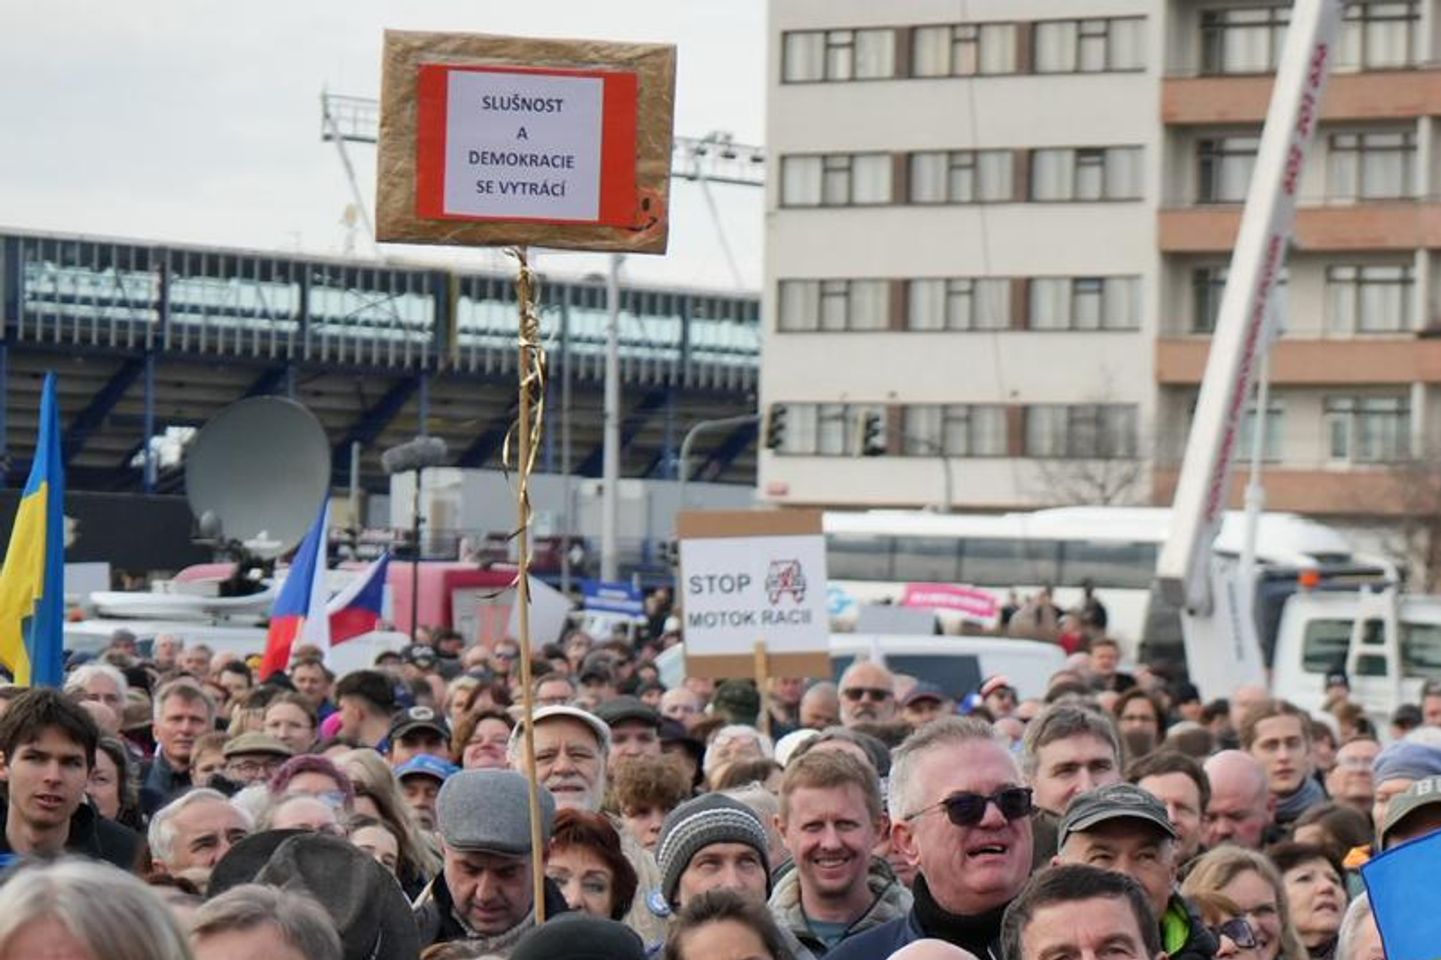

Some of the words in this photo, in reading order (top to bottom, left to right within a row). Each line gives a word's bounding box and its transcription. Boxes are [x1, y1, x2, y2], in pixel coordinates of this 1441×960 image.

[482, 94, 563, 113] SLUŠNOST
[516, 126, 528, 140] A
[468, 150, 575, 169] DEMOKRACIE
[477, 180, 494, 195] SE
[499, 180, 566, 197] VYTRÁCÍ
[689, 573, 751, 595] STOP
